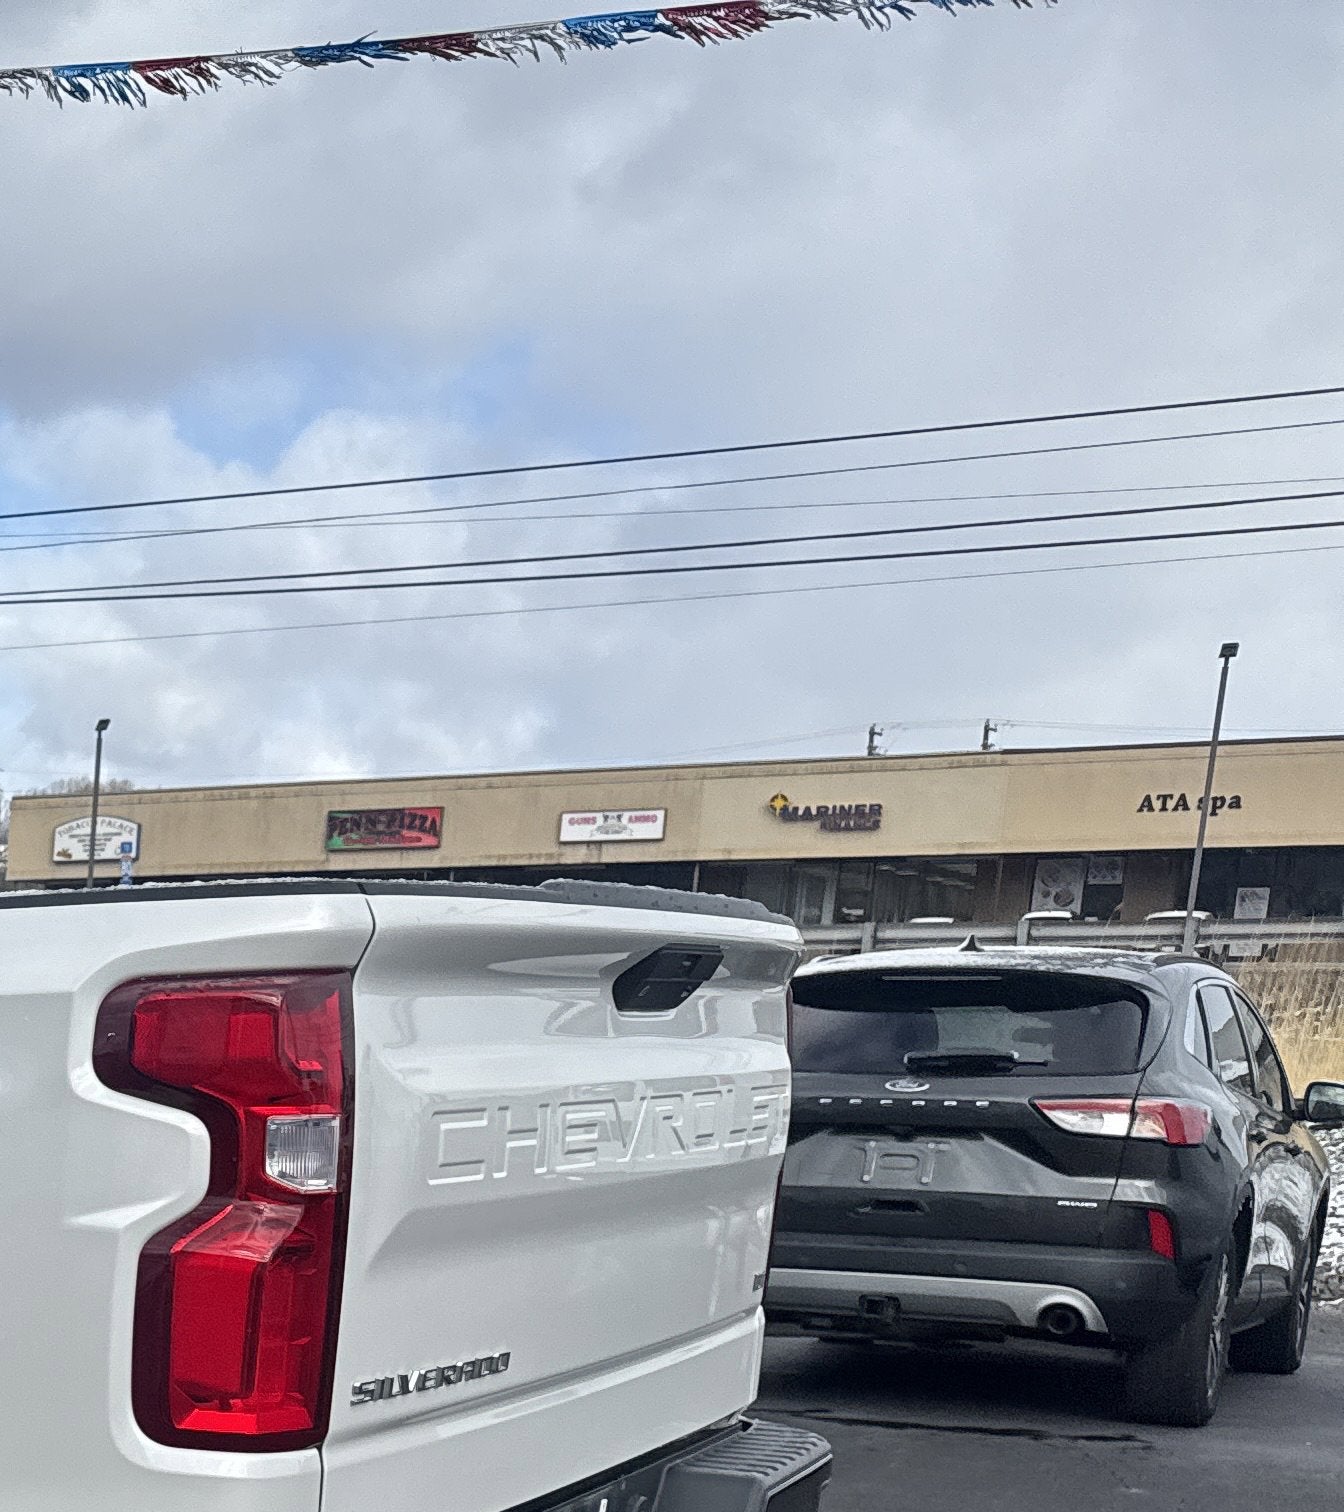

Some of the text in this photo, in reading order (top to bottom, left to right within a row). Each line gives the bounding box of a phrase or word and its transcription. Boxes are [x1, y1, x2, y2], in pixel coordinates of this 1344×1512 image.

[1137, 793, 1191, 812] ATA
[568, 817, 597, 826] GUNS
[780, 804, 882, 821] MARINER
[350, 1352, 511, 1407] SILVERADO
